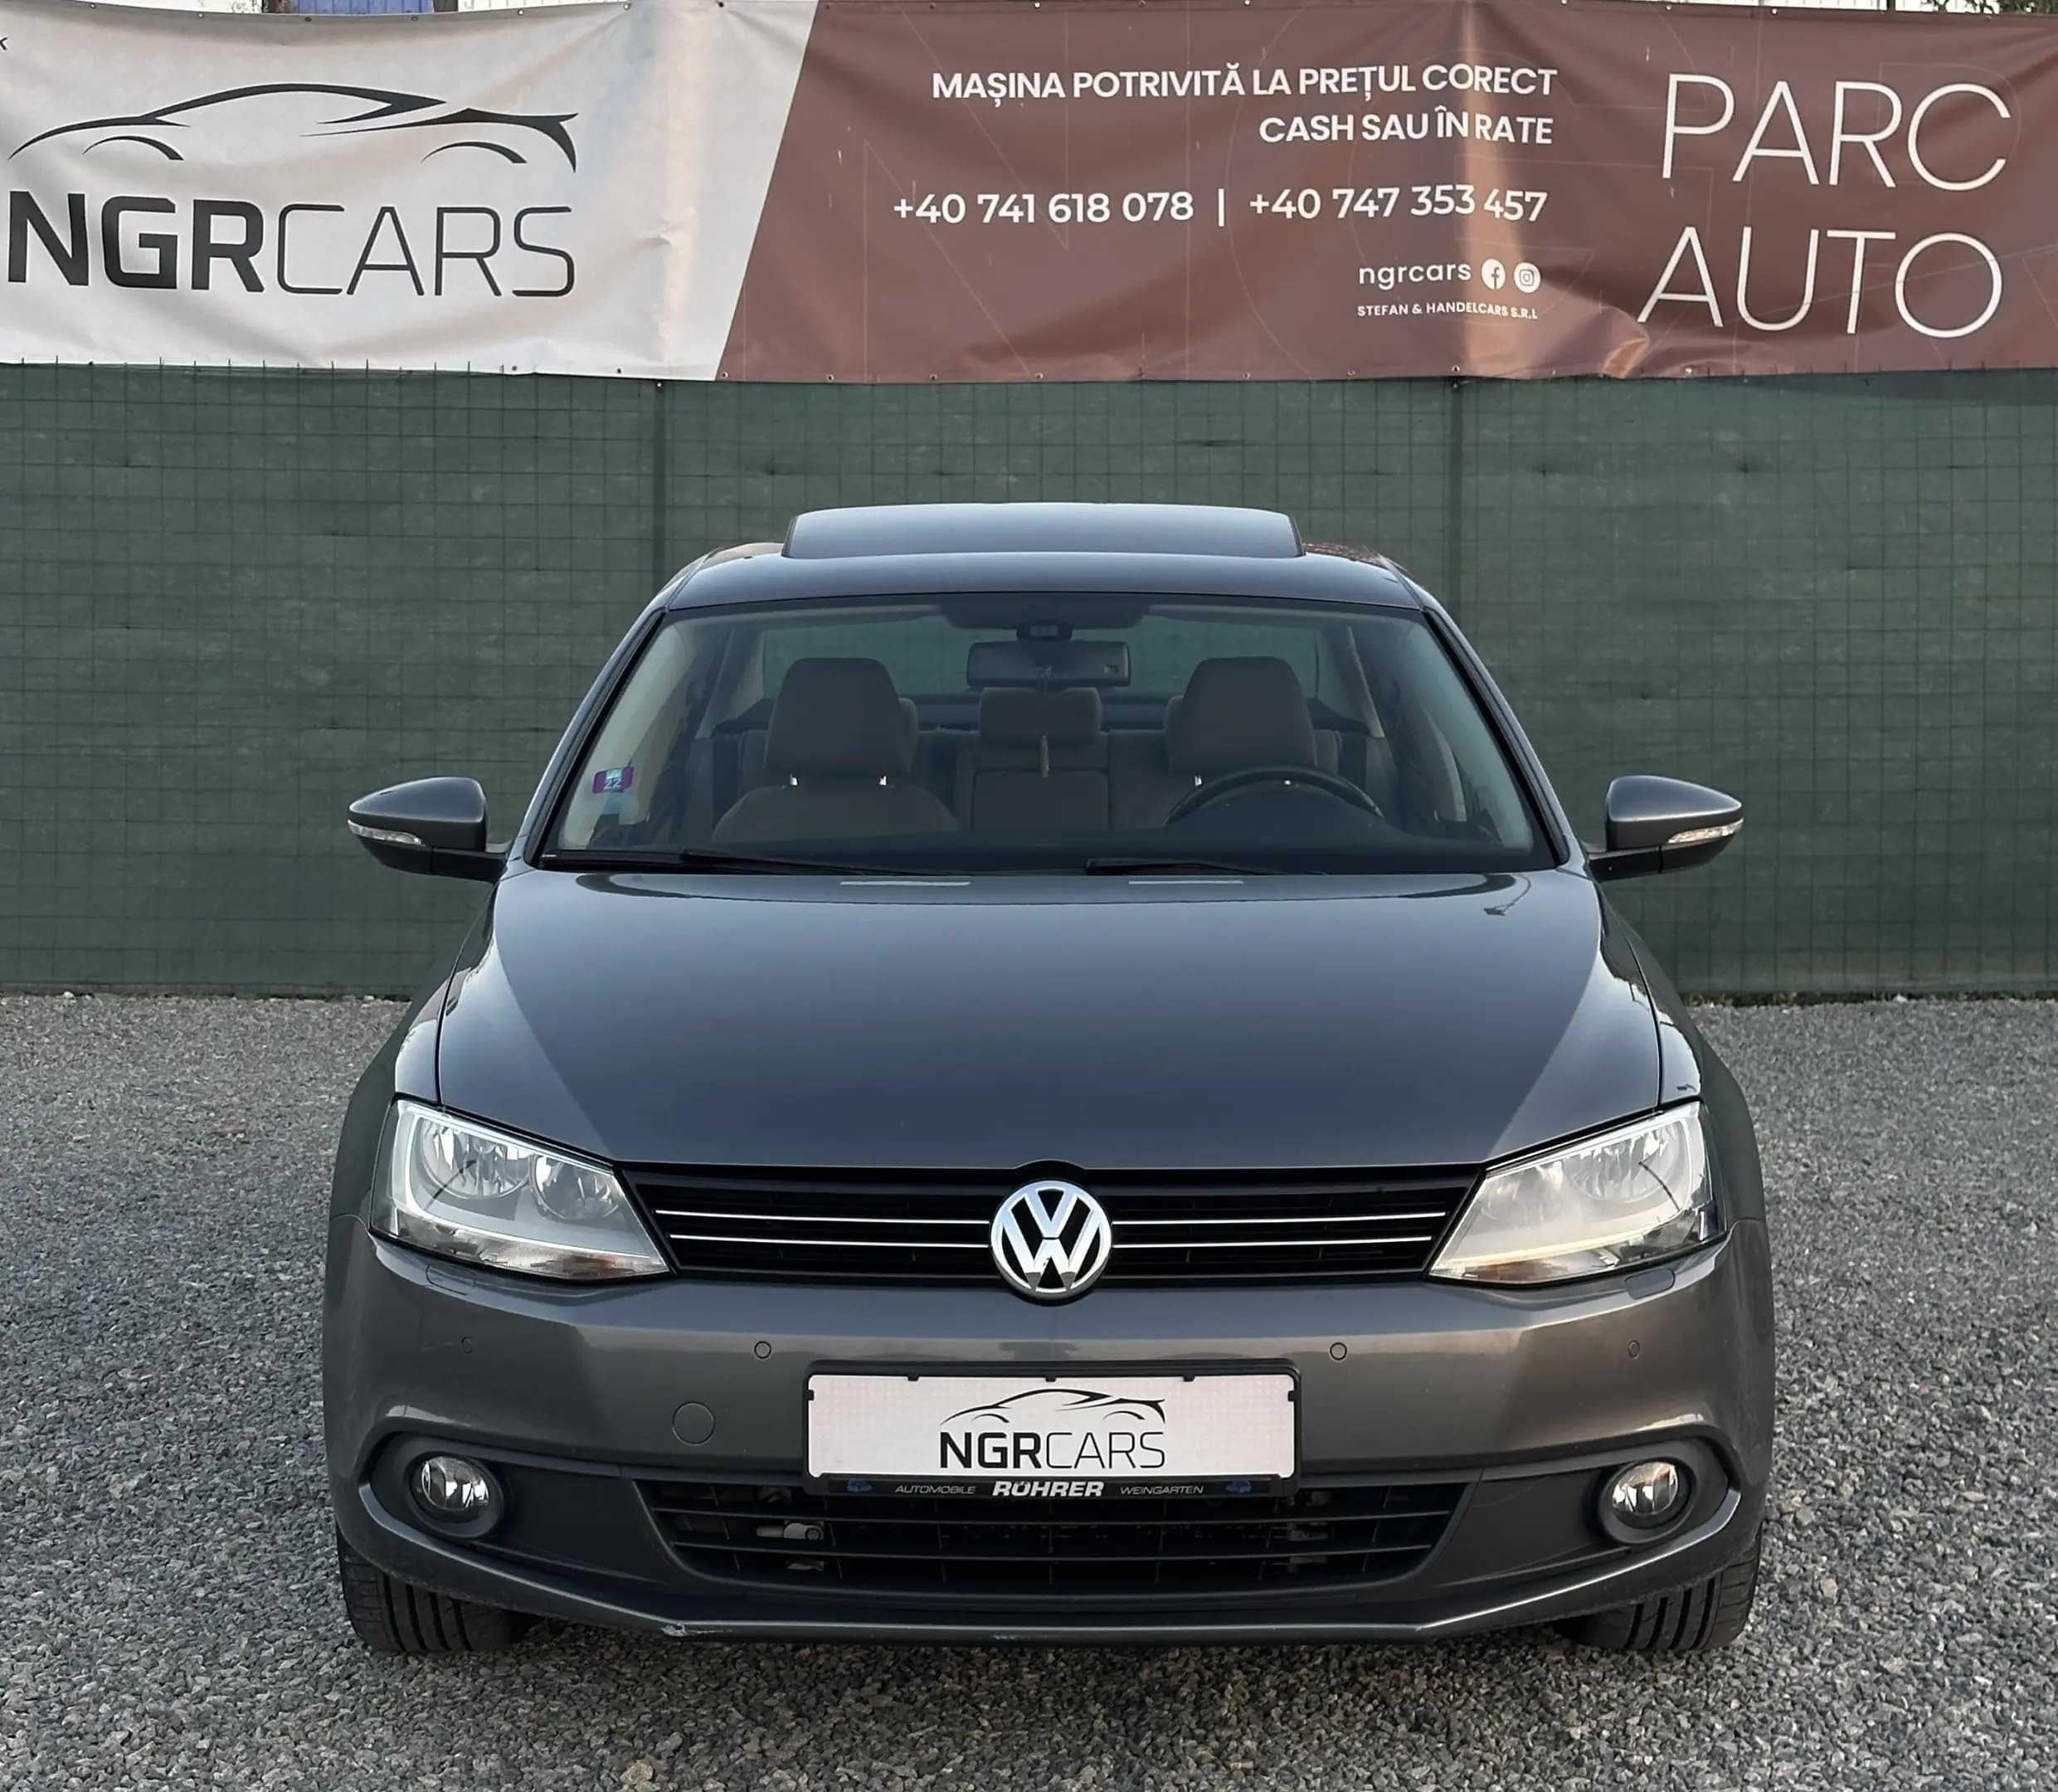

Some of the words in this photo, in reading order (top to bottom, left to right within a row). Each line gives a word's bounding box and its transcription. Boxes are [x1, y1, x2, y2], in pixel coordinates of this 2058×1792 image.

[932, 71, 1067, 106] MAȘINA
[1073, 62, 1246, 98] POTRIVITĂ
[1253, 69, 1292, 95] LA
[1299, 65, 1416, 101] PREȚUL
[1422, 63, 1558, 95] CORECT
[1258, 115, 1355, 144] CASH
[1360, 114, 1429, 141] SAU
[1436, 105, 1470, 139] ÎN
[1475, 113, 1554, 144] RATE
[1662, 73, 2012, 191] PARC
[893, 193, 966, 223] +40
[977, 194, 1037, 223] 741
[1048, 193, 1110, 223] 618
[1121, 191, 1194, 221] 078
[1249, 189, 1321, 219] +40
[1332, 187, 1402, 219] 747
[1409, 184, 1477, 215] 353
[1483, 189, 1548, 223] 457
[7, 190, 576, 298] NGRCARS
[1359, 262, 1472, 290] ngrcars
[1637, 226, 2002, 338] AUTO
[1357, 304, 1408, 317] STEFAN
[1412, 303, 1423, 314] &
[1426, 301, 1507, 317] HANDELCARS
[991, 1180, 1112, 1301] VW
[940, 1432, 1165, 1469] NGRCARS
[895, 1486, 975, 1495] AUTOMOBILE
[993, 1480, 1103, 1497] RÖHRER
[1120, 1486, 1204, 1495] WEINGARTEN
